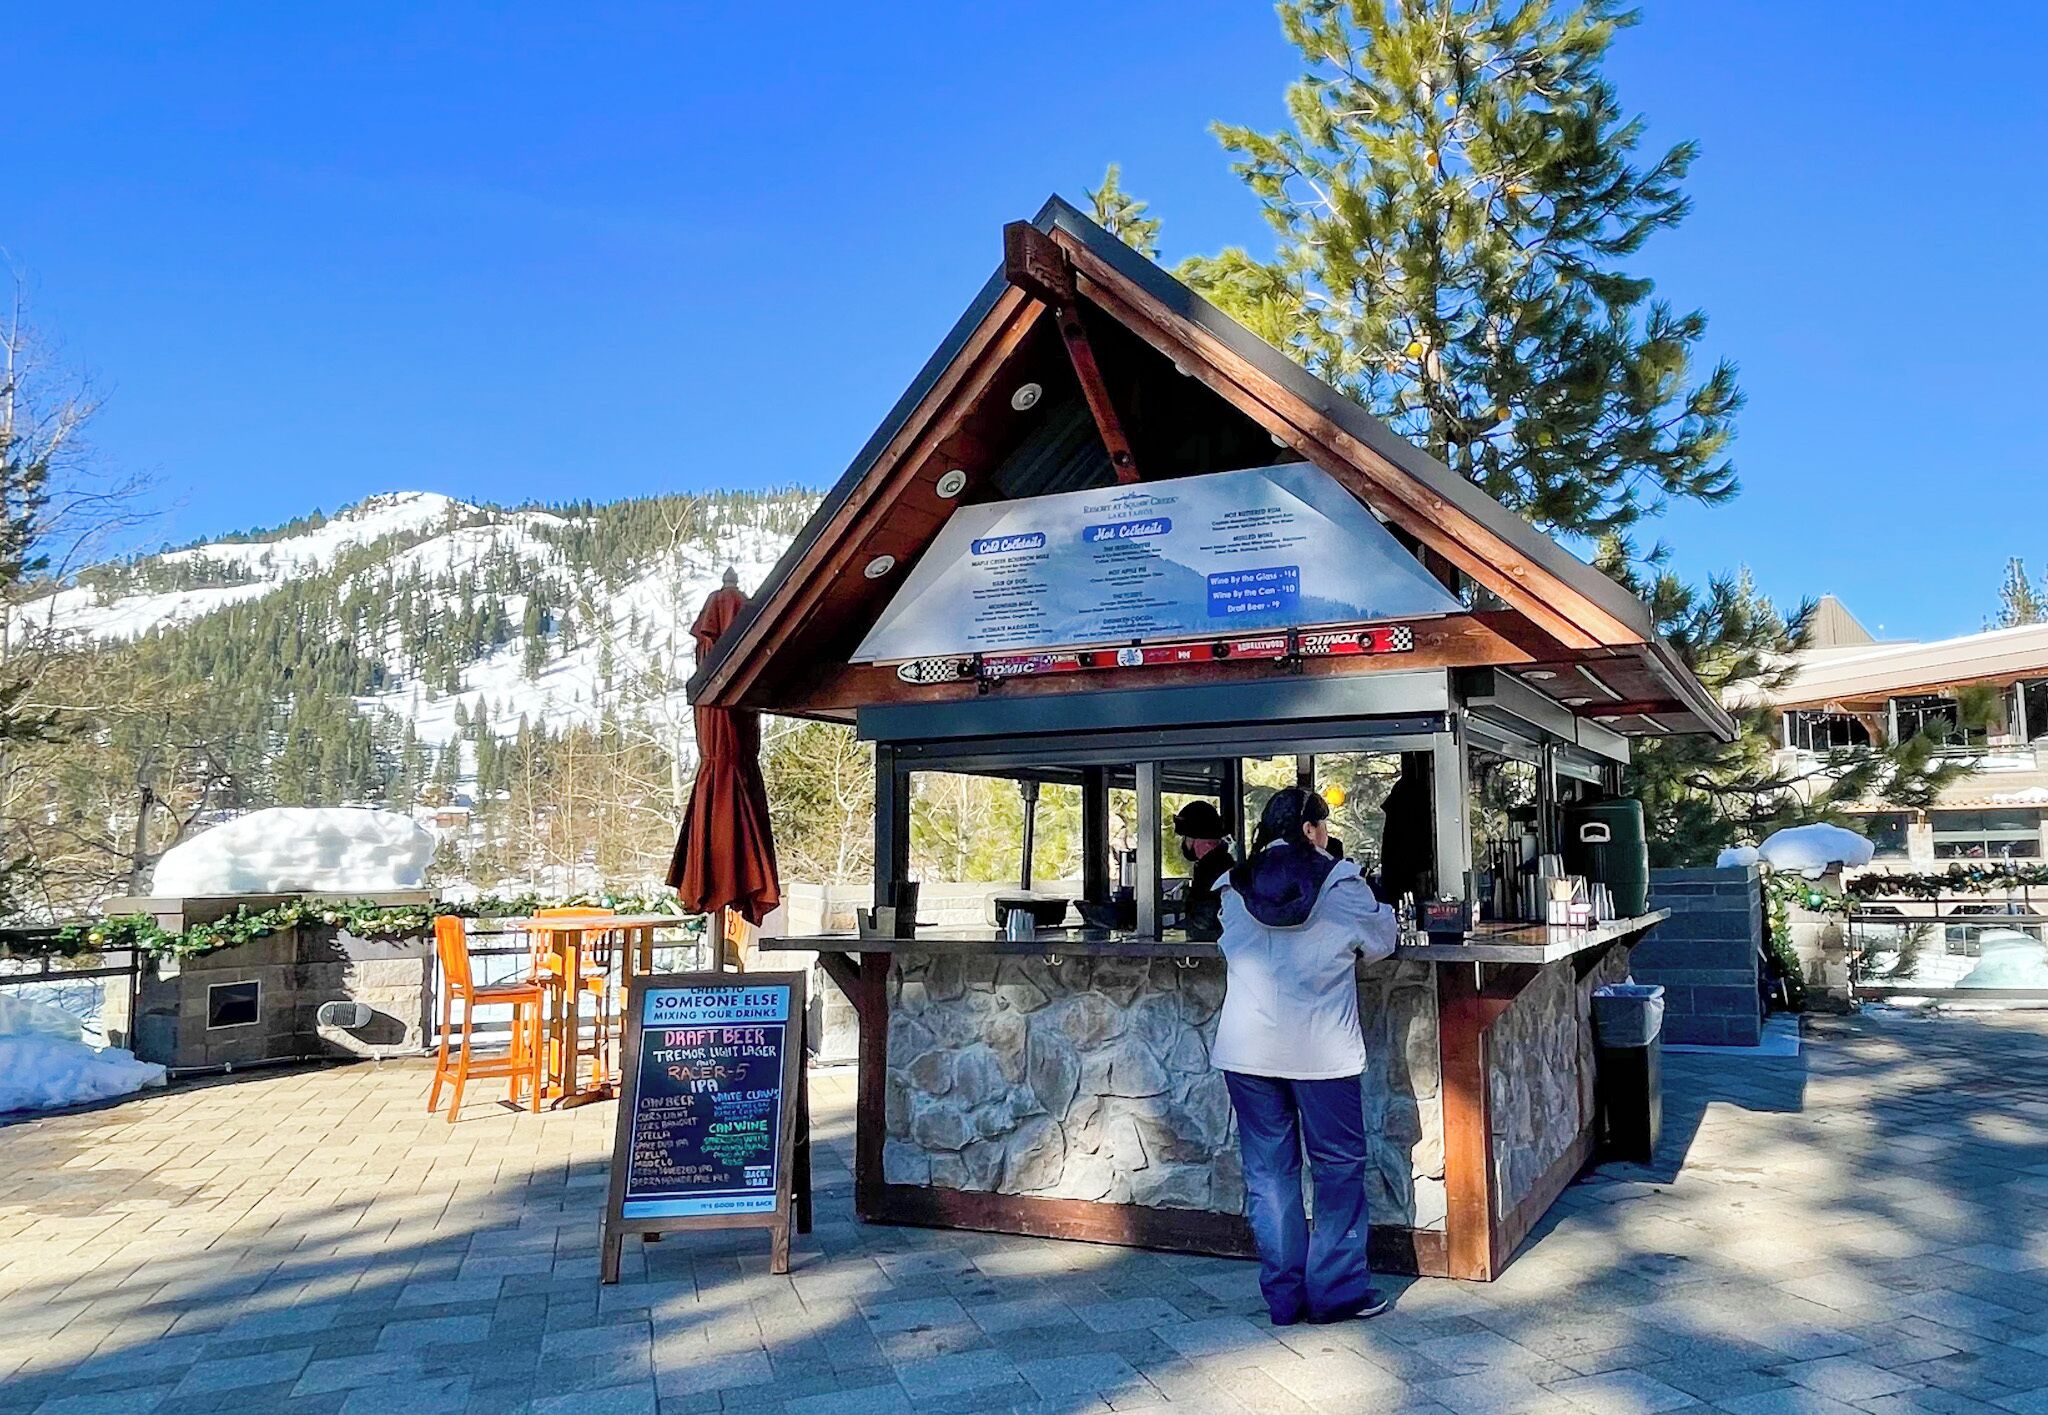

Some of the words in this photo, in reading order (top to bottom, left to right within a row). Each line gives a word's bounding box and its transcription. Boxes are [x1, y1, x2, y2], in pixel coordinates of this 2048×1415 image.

[656, 995, 738, 1008] SOMEONE
[744, 994, 778, 1006] ELSE
[654, 1010, 697, 1021] MIXING
[702, 1010, 732, 1018] YOUR
[736, 1008, 776, 1018] DRINKS
[664, 1029, 719, 1047] DRAFT
[722, 1028, 765, 1045] BEER
[652, 1049, 706, 1063] TREMOR
[710, 1046, 738, 1057] LIGHT
[742, 1045, 776, 1057] LAGER
[690, 1080, 718, 1093] IPA
[665, 1095, 694, 1106] BEER
[709, 1122, 732, 1133] CAN
[734, 1120, 768, 1131] WINE
[637, 1131, 670, 1141] STELLA
[635, 1150, 668, 1160] STELLA
[634, 1158, 673, 1168] MODELO
